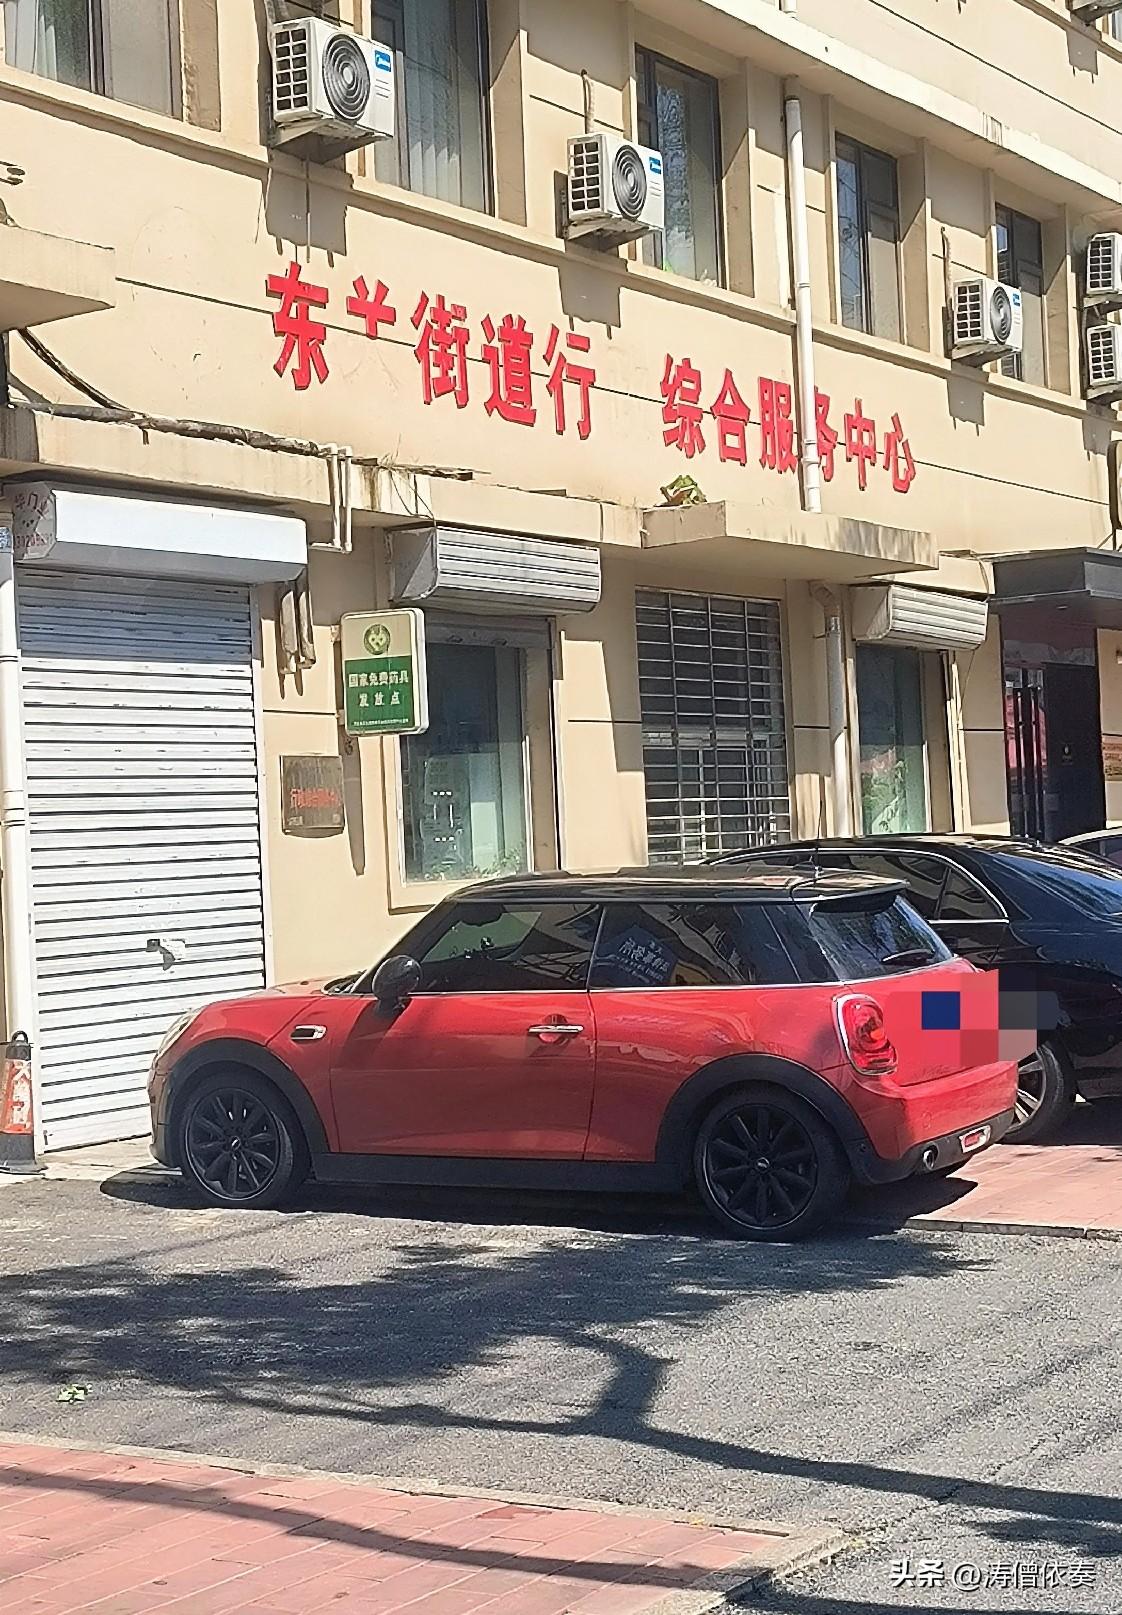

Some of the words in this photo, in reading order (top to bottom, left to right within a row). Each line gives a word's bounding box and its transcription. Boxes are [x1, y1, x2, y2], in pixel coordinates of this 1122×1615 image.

[659, 353, 918, 494] 综合服务中心
[348, 669, 409, 688] 国家免费药具
[358, 691, 401, 707] 发放点
